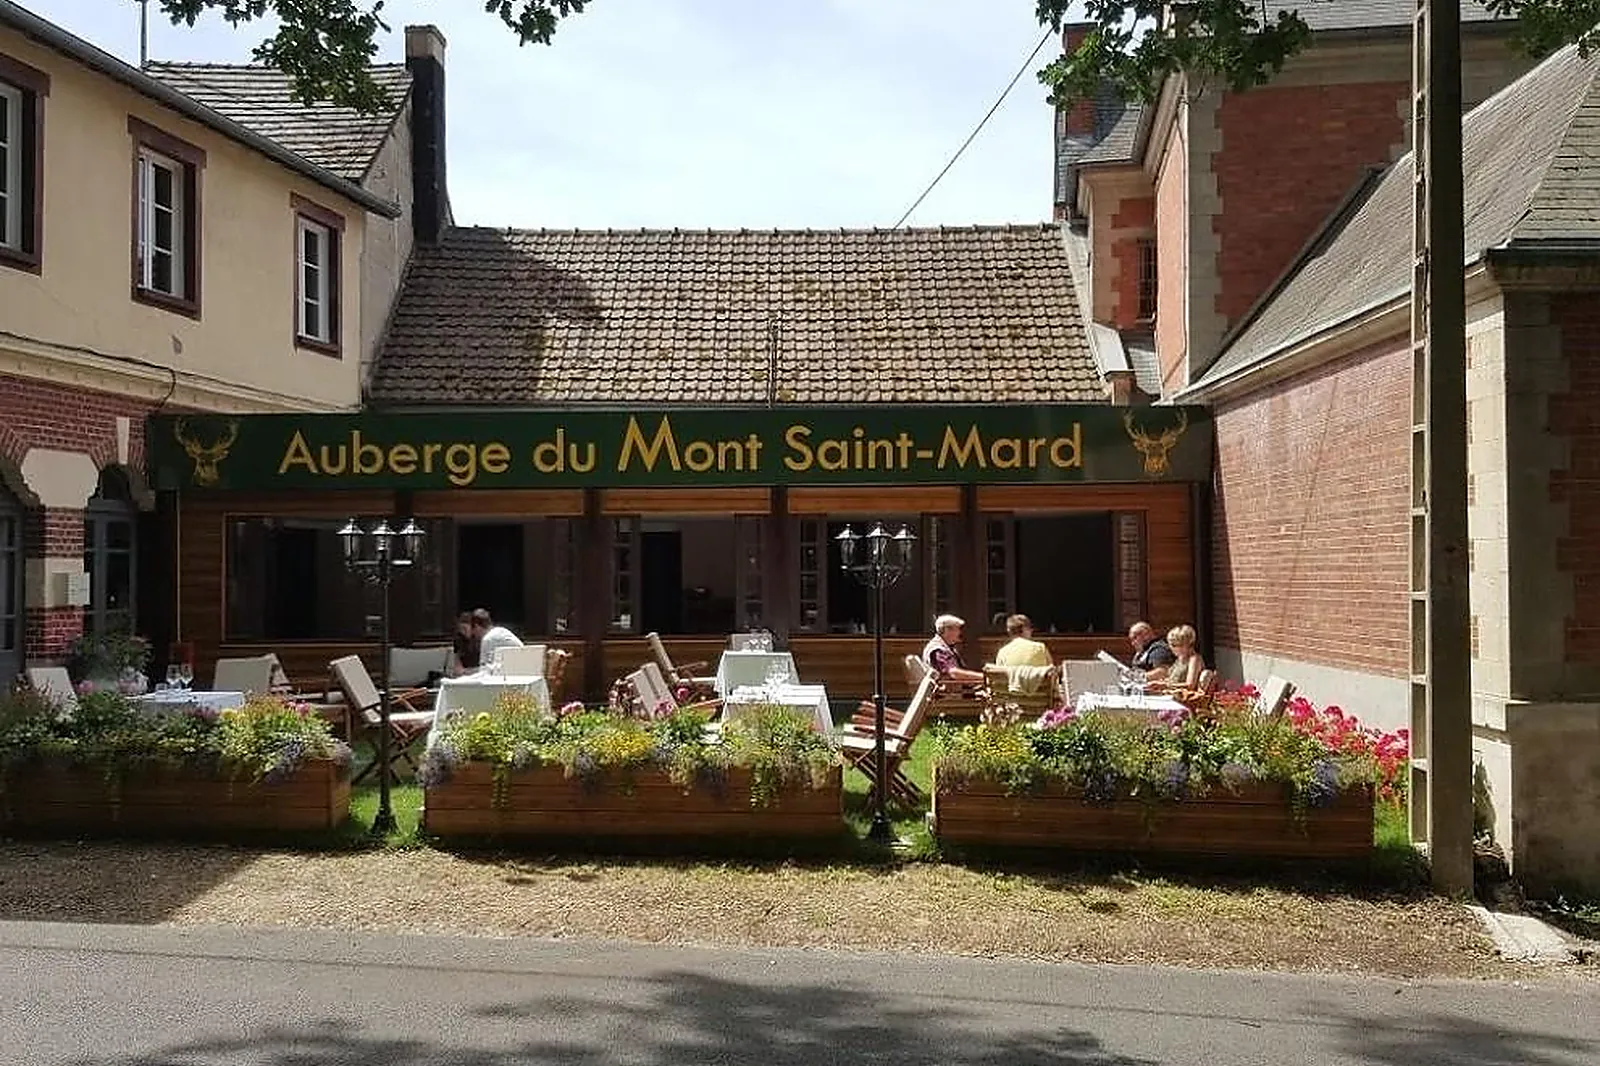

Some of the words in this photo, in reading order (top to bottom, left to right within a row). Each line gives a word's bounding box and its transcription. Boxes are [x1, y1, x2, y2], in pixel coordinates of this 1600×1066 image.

[278, 429, 510, 485] Auberge
[534, 428, 594, 473] du
[618, 415, 763, 473] Mont
[784, 422, 1082, 472] Saint-Mard
